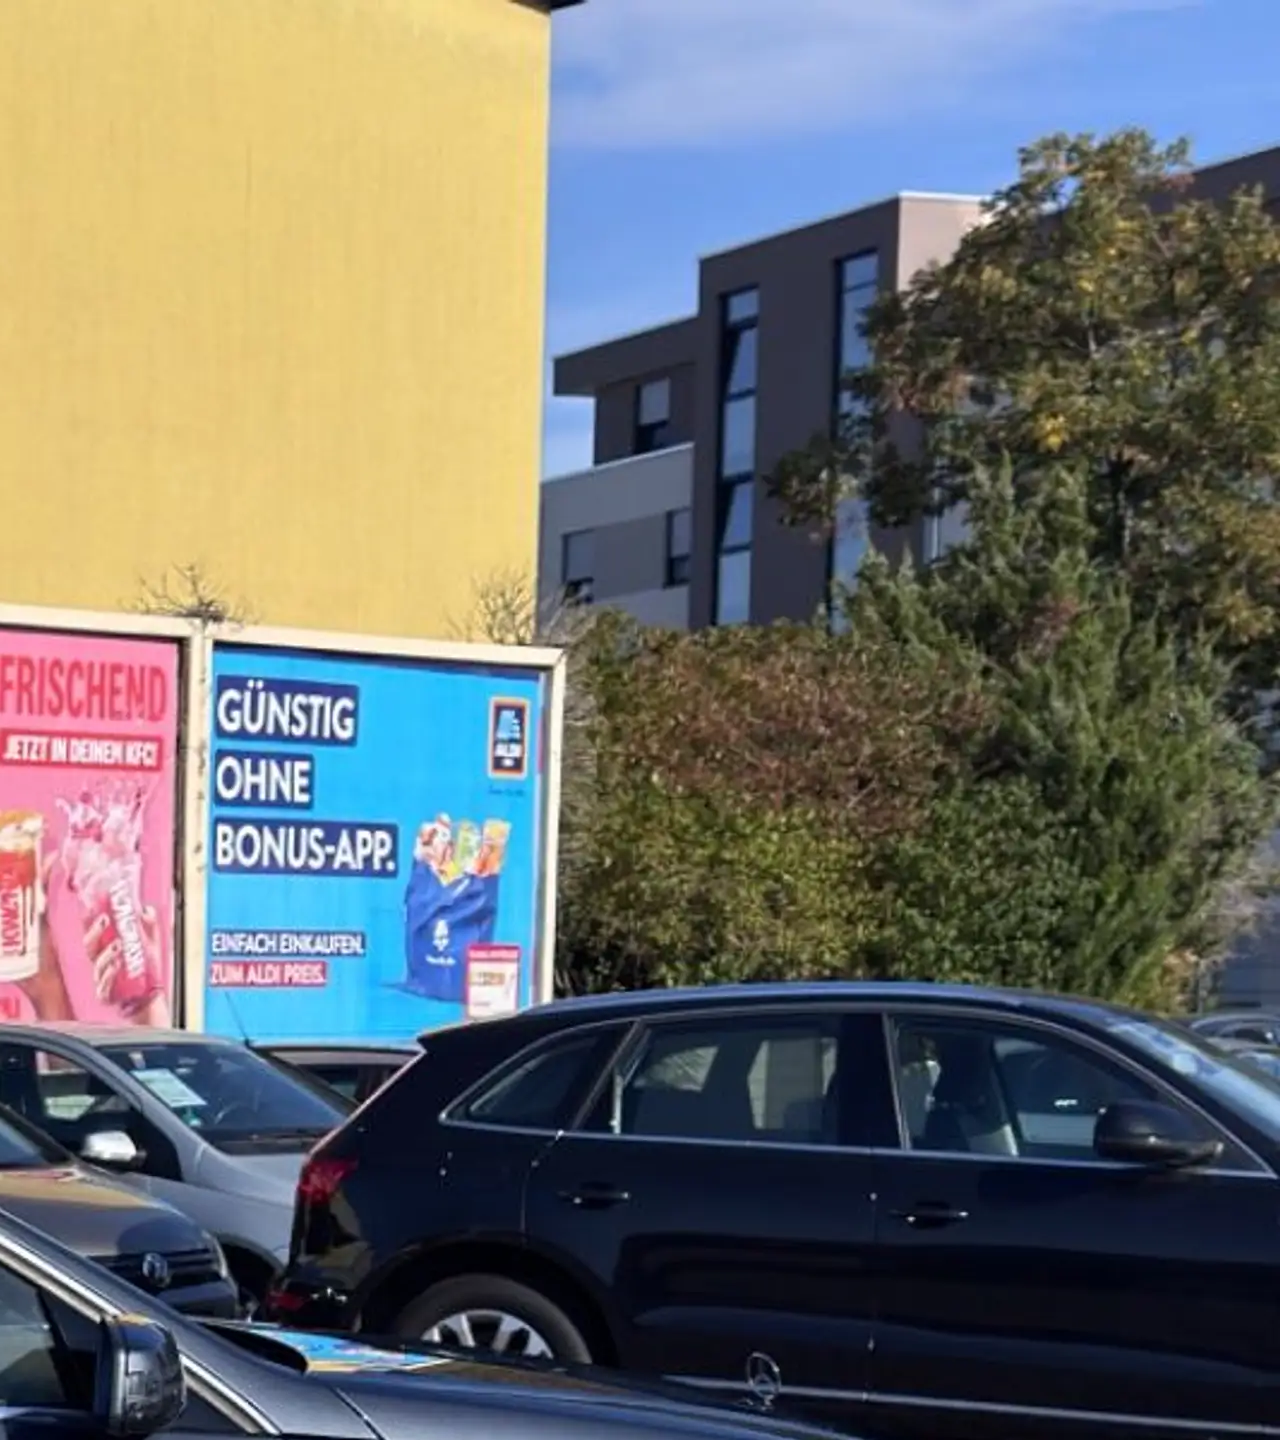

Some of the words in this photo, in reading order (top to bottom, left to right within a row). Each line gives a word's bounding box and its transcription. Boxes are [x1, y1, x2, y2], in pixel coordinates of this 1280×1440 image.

[216, 680, 356, 741] GÜNSTIG
[2, 734, 50, 761] JETZT
[51, 737, 68, 763] IN
[215, 756, 313, 804] OHNE
[215, 823, 397, 871] BONUS-APP.
[211, 932, 277, 953] EINFACH
[210, 963, 244, 984] ZUM
[246, 963, 281, 985] ALDI
